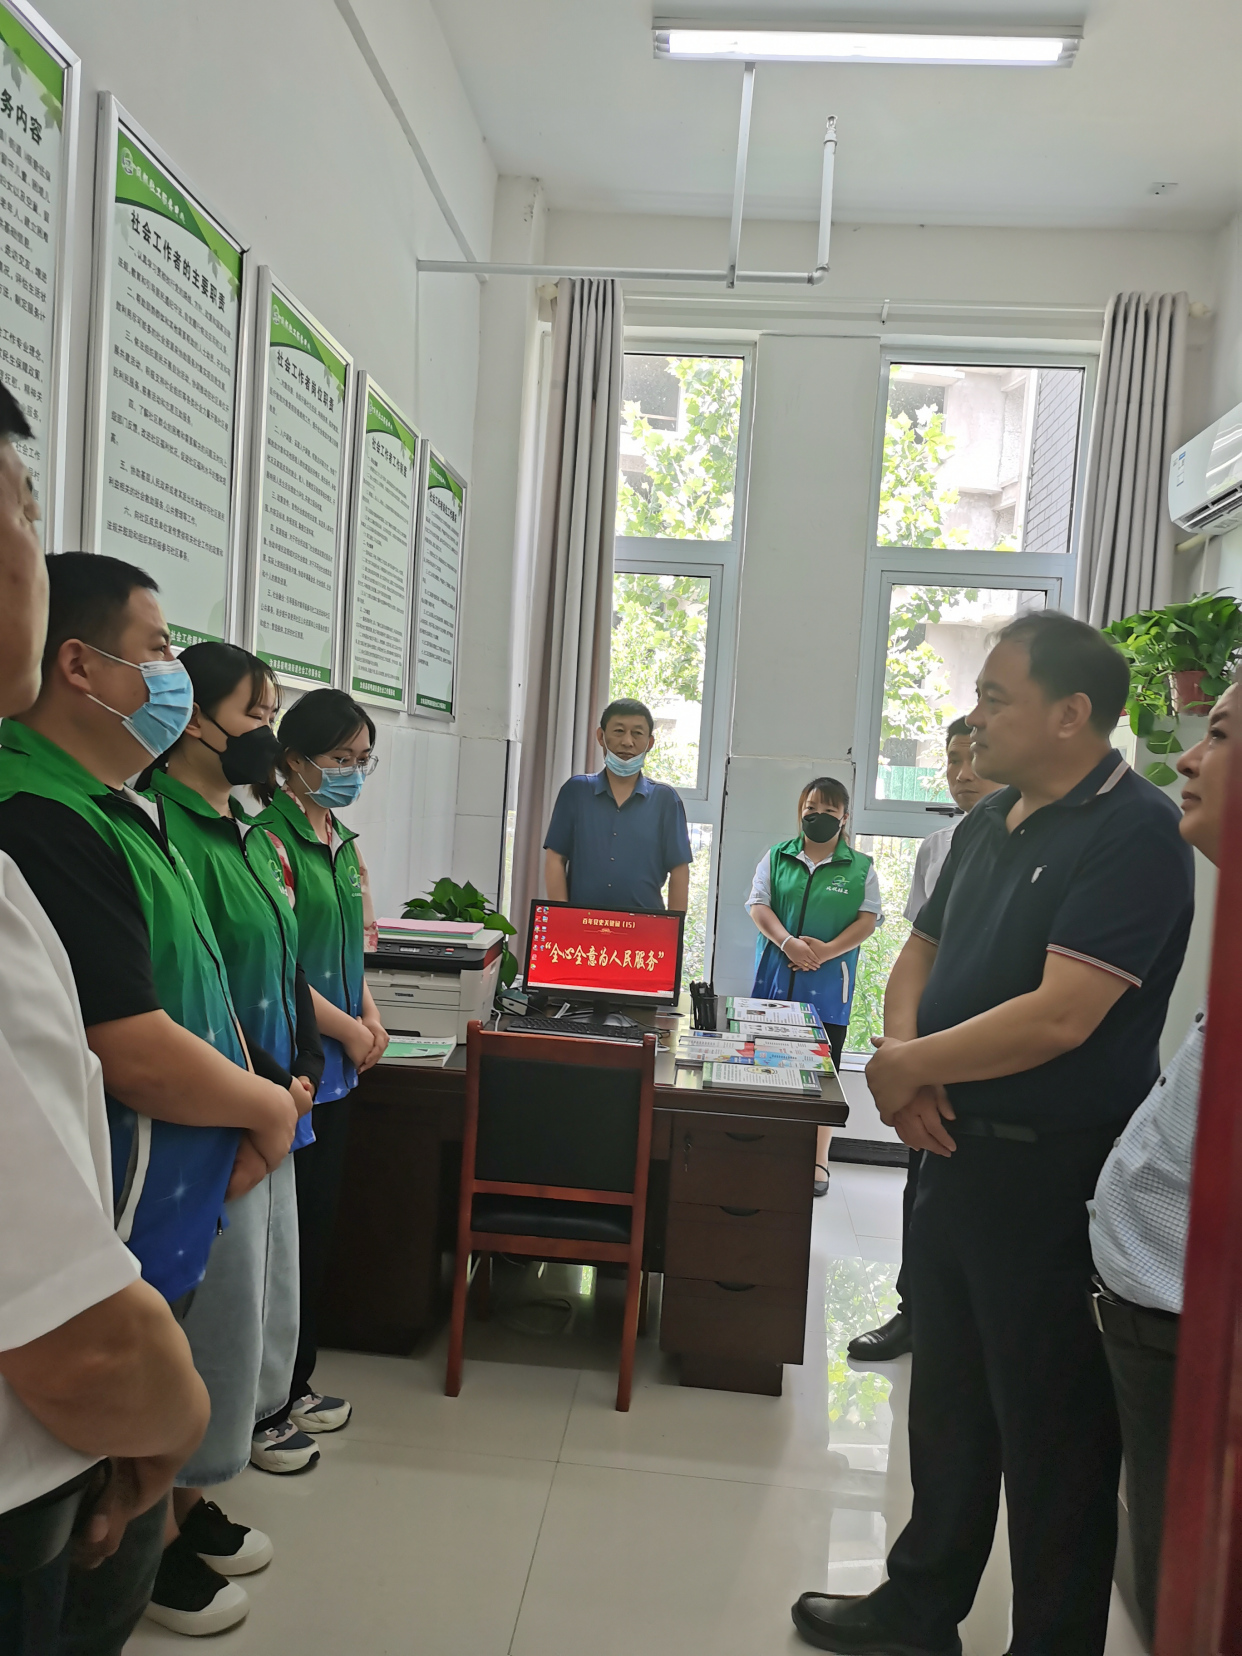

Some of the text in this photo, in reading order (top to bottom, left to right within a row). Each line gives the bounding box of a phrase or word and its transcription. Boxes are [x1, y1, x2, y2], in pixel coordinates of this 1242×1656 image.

[0, 88, 42, 146] 务内容
[130, 208, 226, 314] 社会工作者的主要职责
[277, 349, 334, 415] 社会工作者岗位职责
[545, 942, 664, 972] “全心全意为人民服务”
